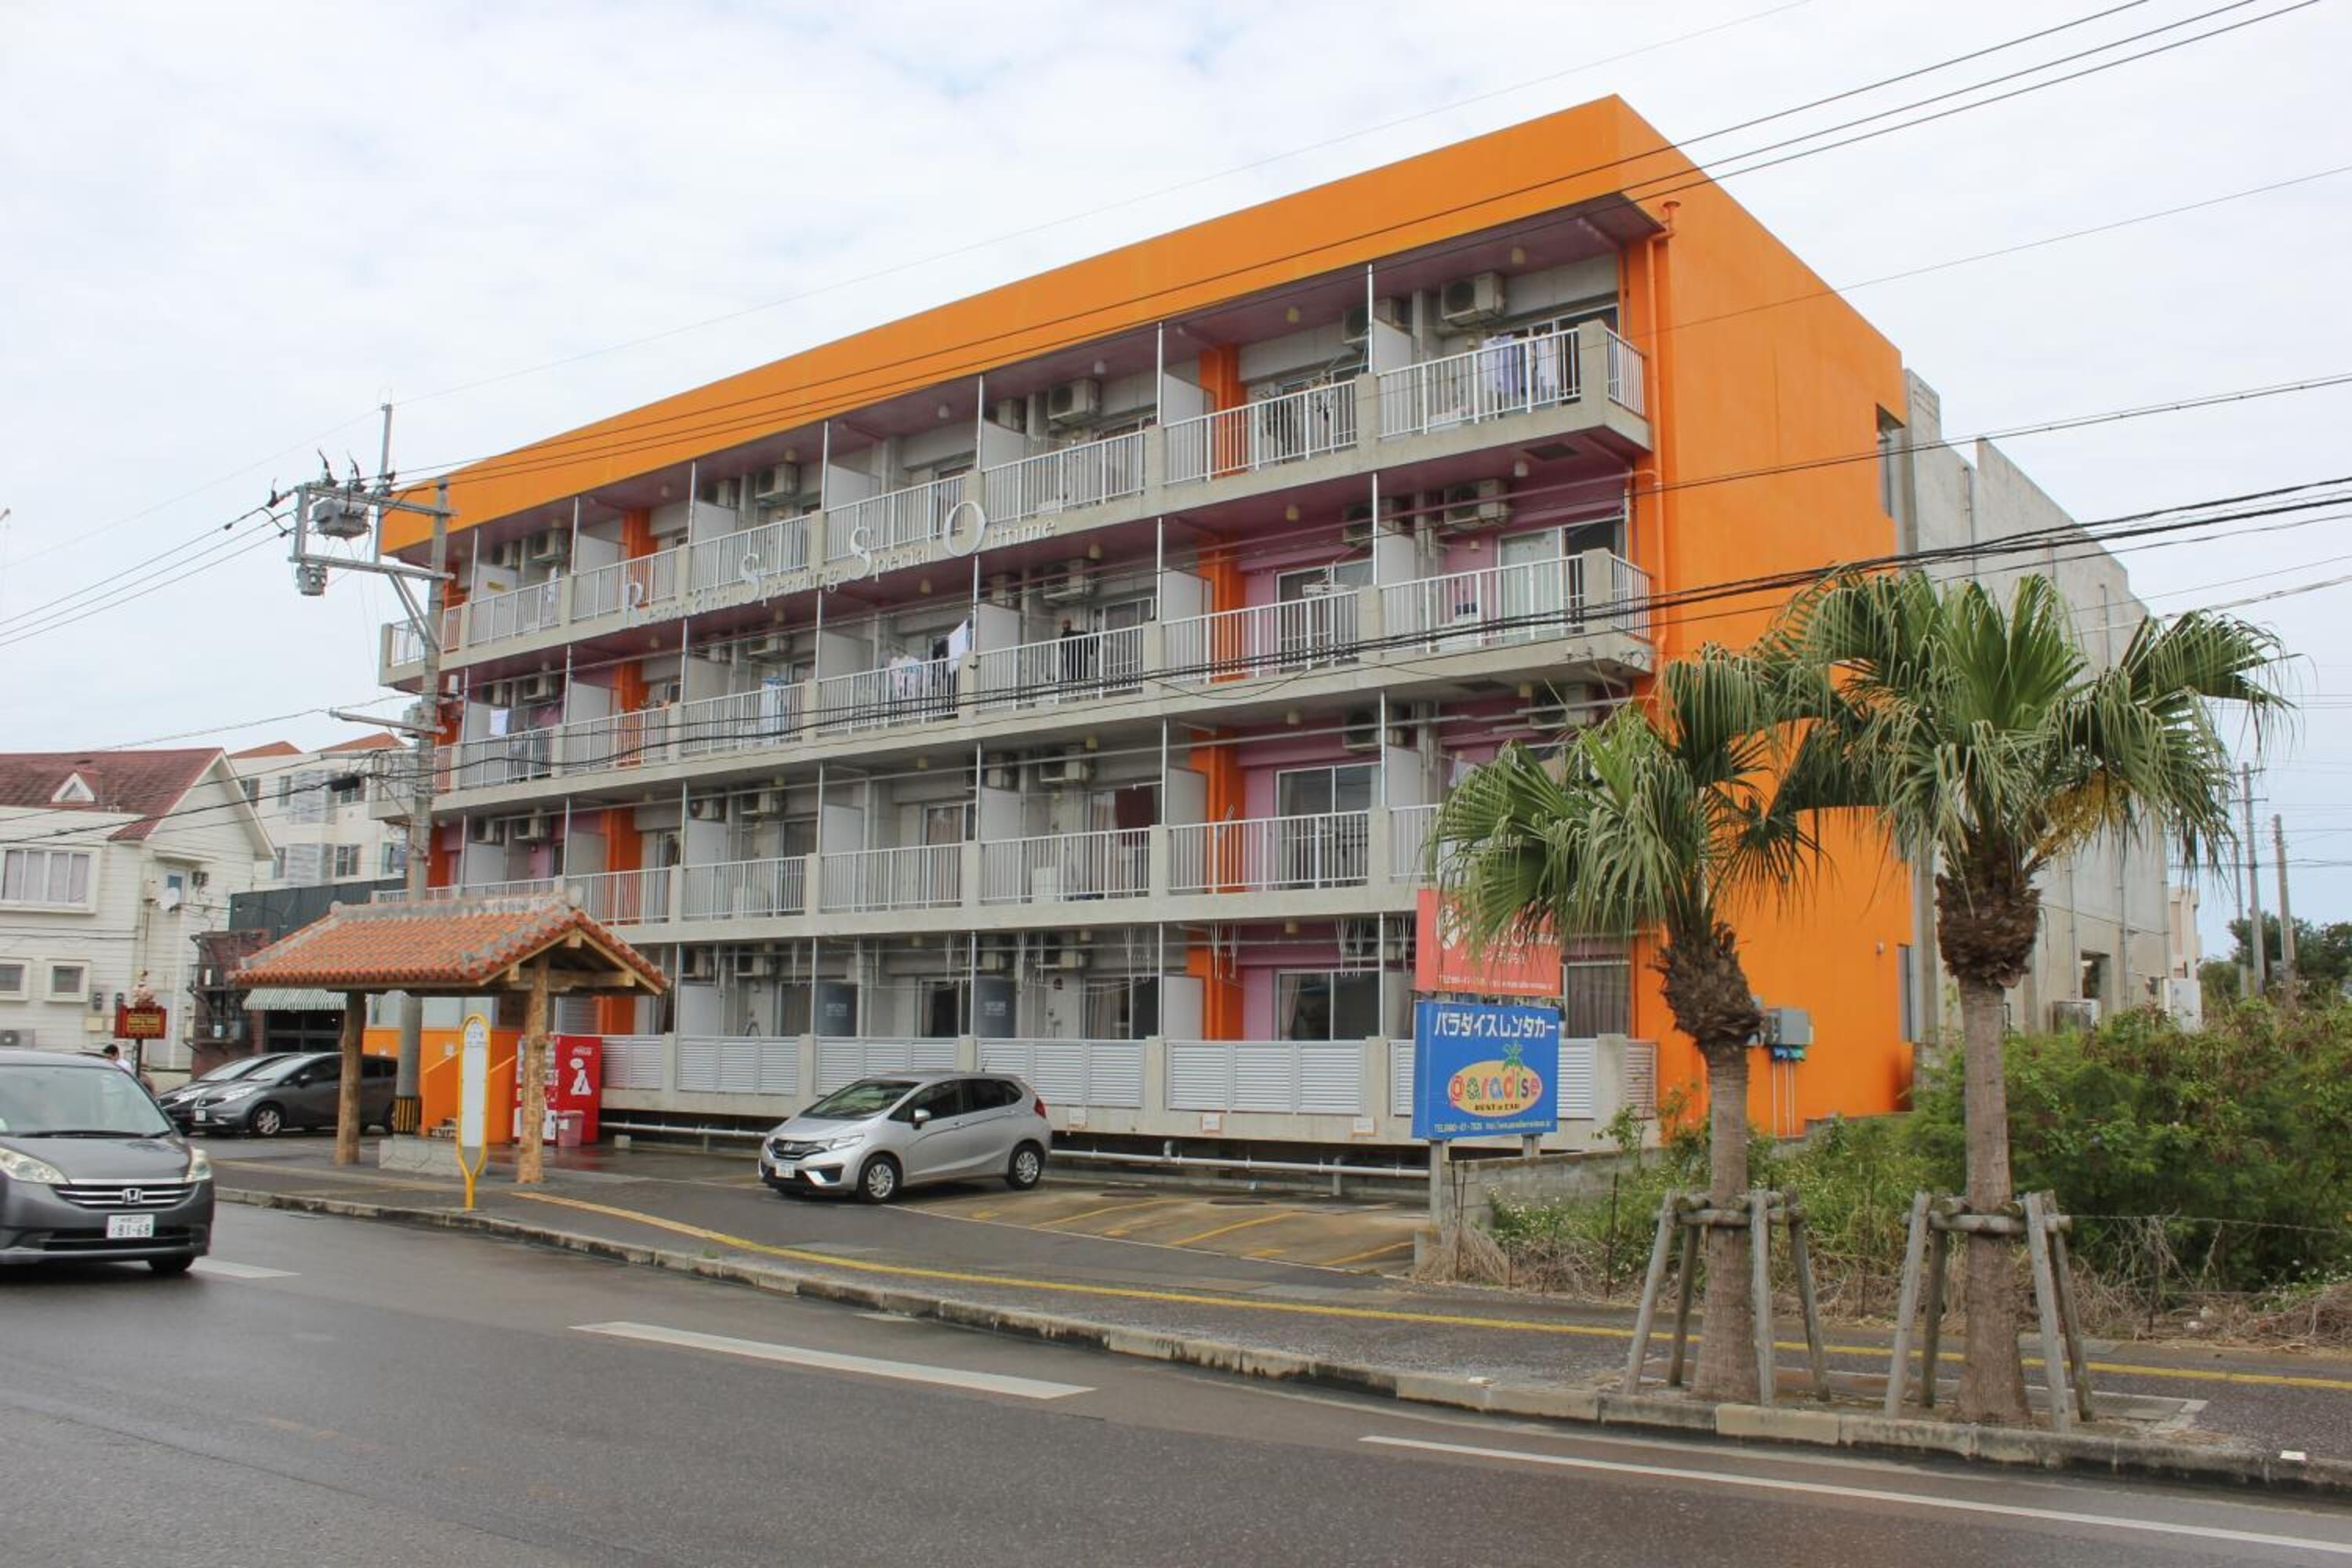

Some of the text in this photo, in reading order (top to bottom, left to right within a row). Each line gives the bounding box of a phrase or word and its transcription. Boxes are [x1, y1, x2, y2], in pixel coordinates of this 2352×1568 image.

[1434, 1012, 1556, 1038] パラダイスレンタカー
[1450, 1068, 1541, 1108] paradise
